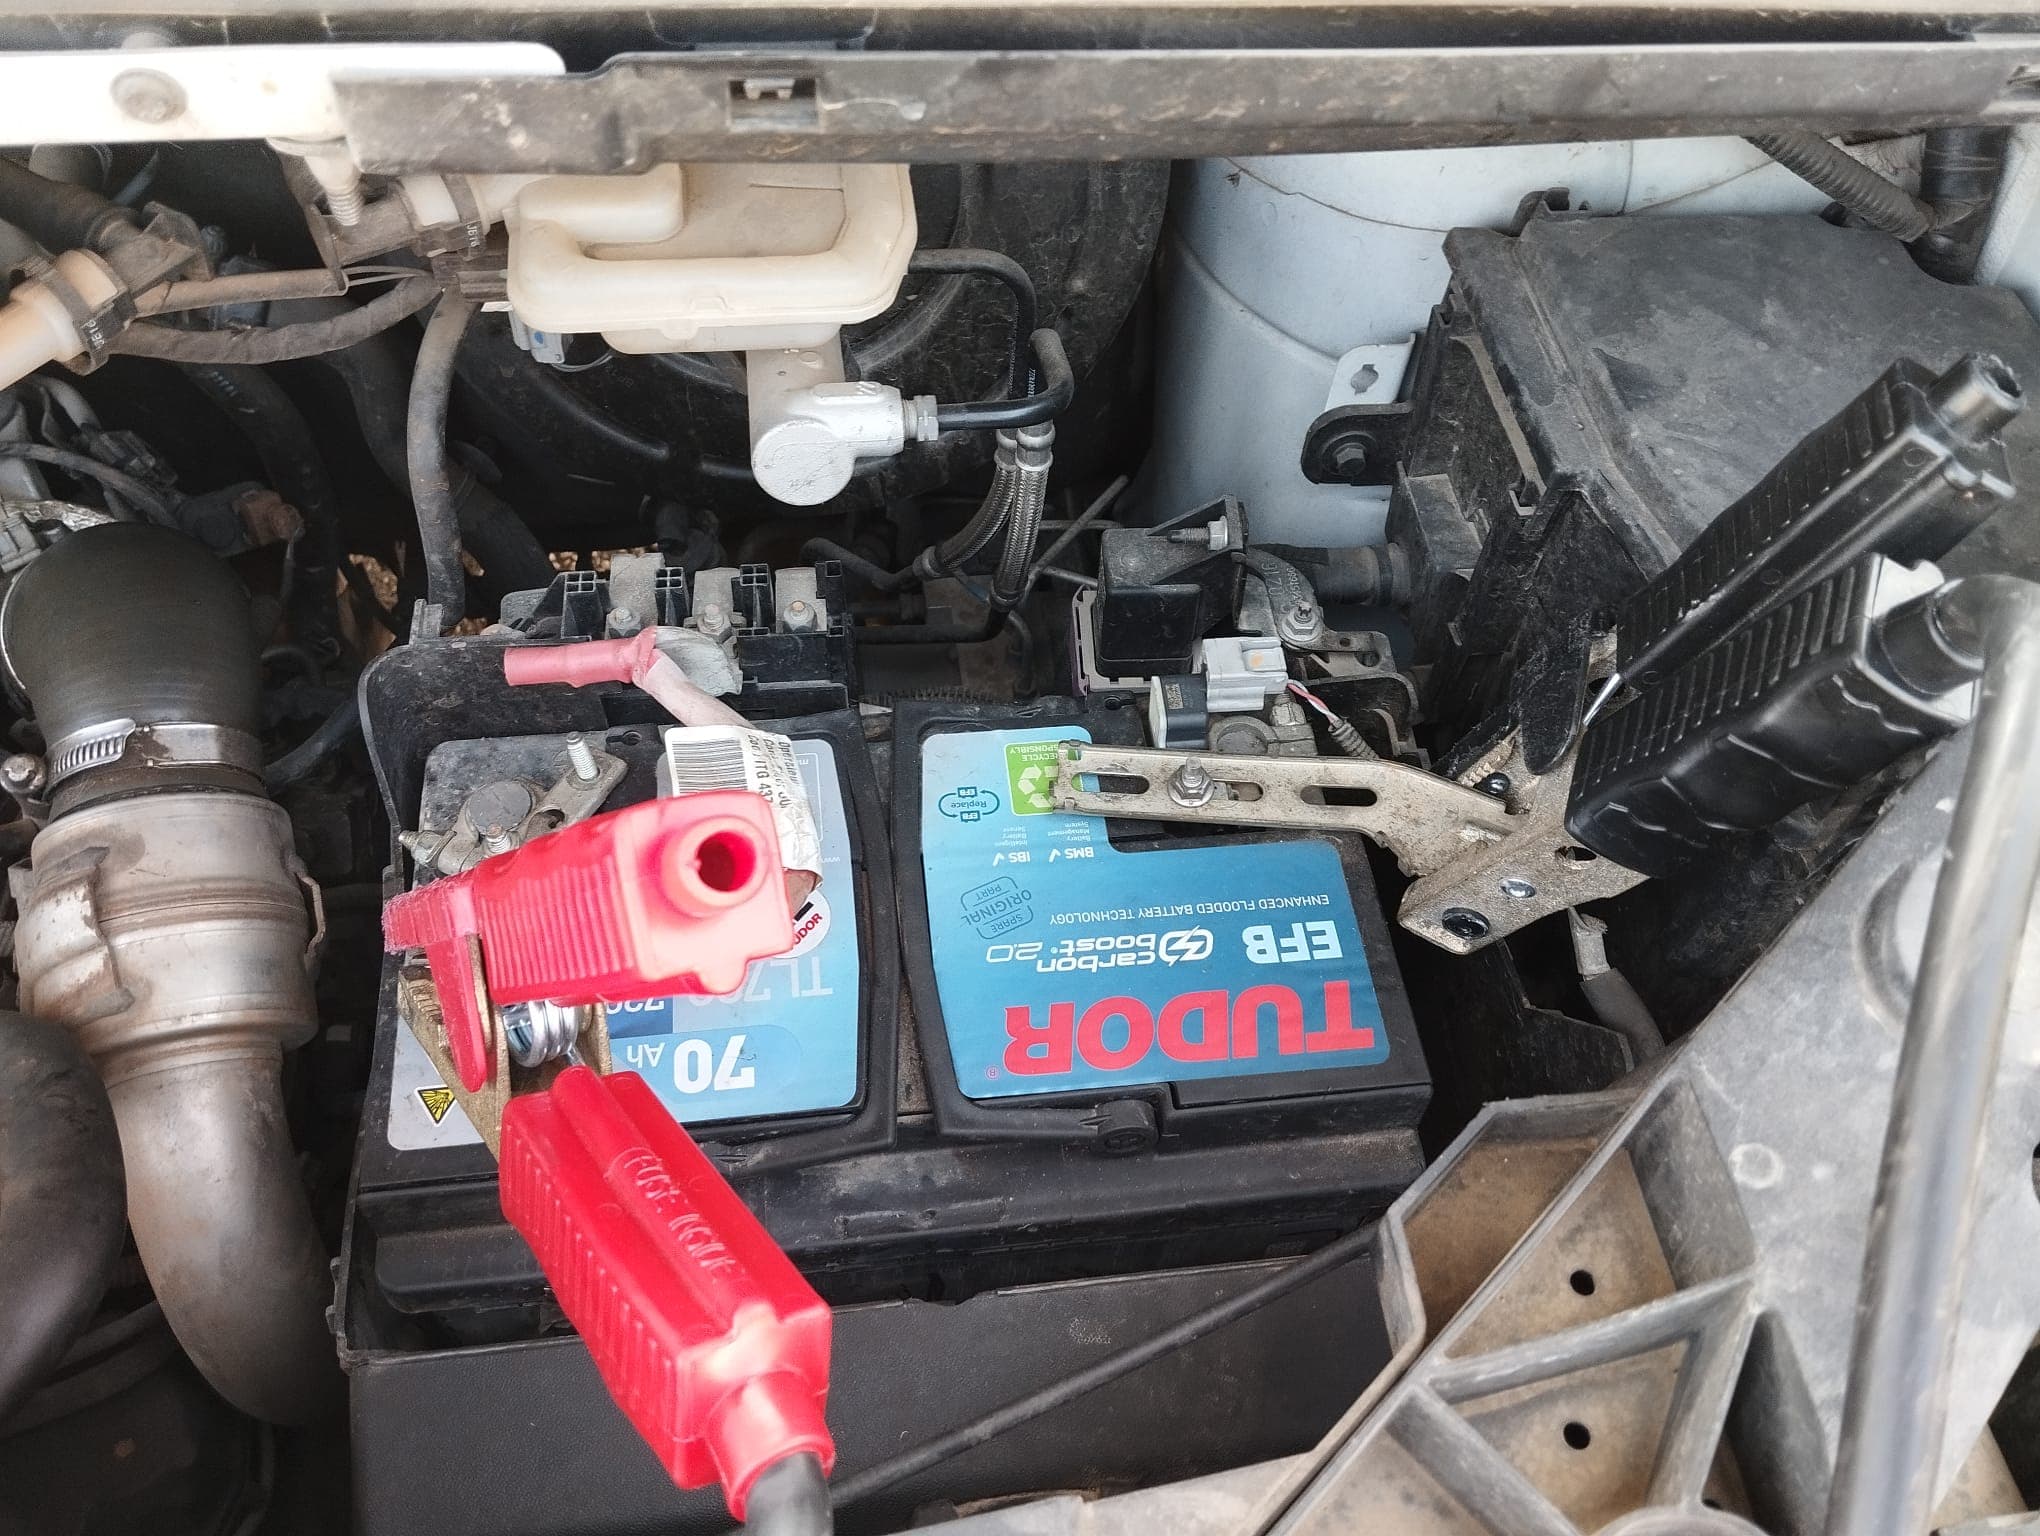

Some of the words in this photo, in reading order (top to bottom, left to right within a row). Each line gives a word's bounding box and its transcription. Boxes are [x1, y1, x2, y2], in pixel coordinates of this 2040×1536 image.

[949, 798, 986, 809] Replace
[1046, 826, 1088, 836] Management
[1007, 850, 1030, 862] IBS
[1063, 845, 1094, 858] BMS
[975, 883, 1001, 900] PART
[1258, 893, 1330, 909] ENHANCED
[960, 889, 1031, 925] ORIGINAL
[1136, 903, 1192, 917] BATTERY
[1195, 899, 1254, 913] FLOODED
[989, 912, 1022, 932] SPARE
[1047, 907, 1134, 925] TECHNOLOGY
[1060, 932, 1156, 954] boost
[1240, 918, 1343, 963] EFB
[984, 940, 1042, 962] 2.0
[1035, 950, 1156, 972] carbon
[1002, 979, 1374, 1076] TUDOR
[626, 1041, 665, 1067] Ah
[672, 1033, 755, 1093] 70
